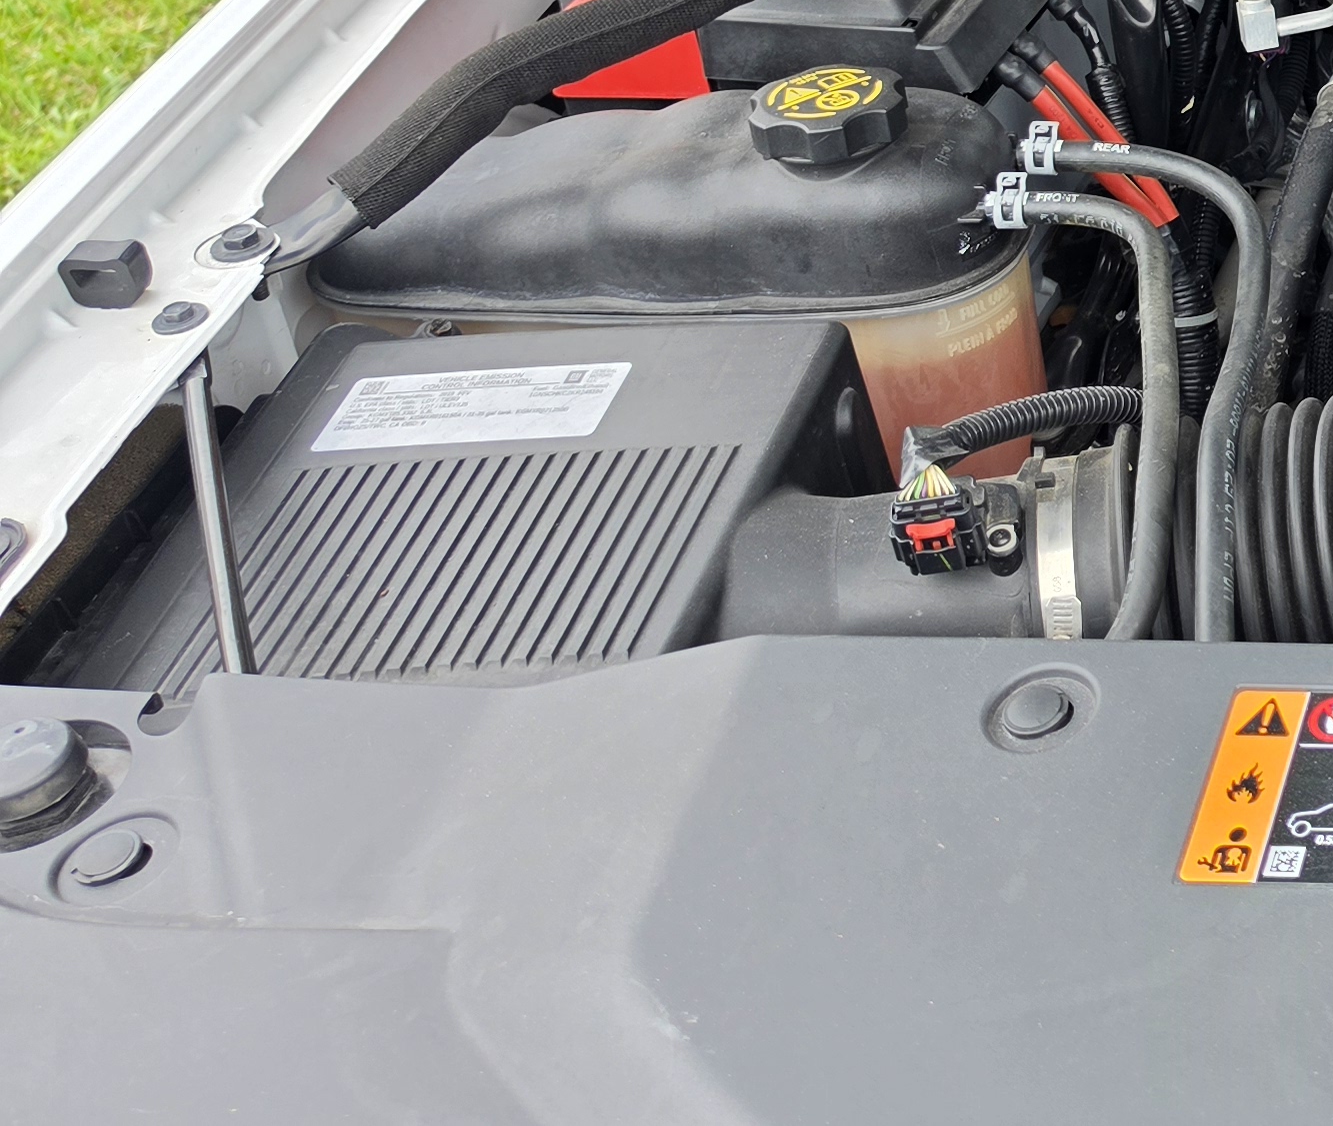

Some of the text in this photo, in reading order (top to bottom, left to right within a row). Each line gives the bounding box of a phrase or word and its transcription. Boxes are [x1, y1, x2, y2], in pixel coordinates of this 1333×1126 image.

[1092, 142, 1131, 154] REAR
[1035, 193, 1080, 202] FRONT
[948, 332, 984, 357] PLEIN
[439, 371, 525, 383] VEHICLE EMISSION
[421, 378, 532, 390] CONTROL INFORMATION
